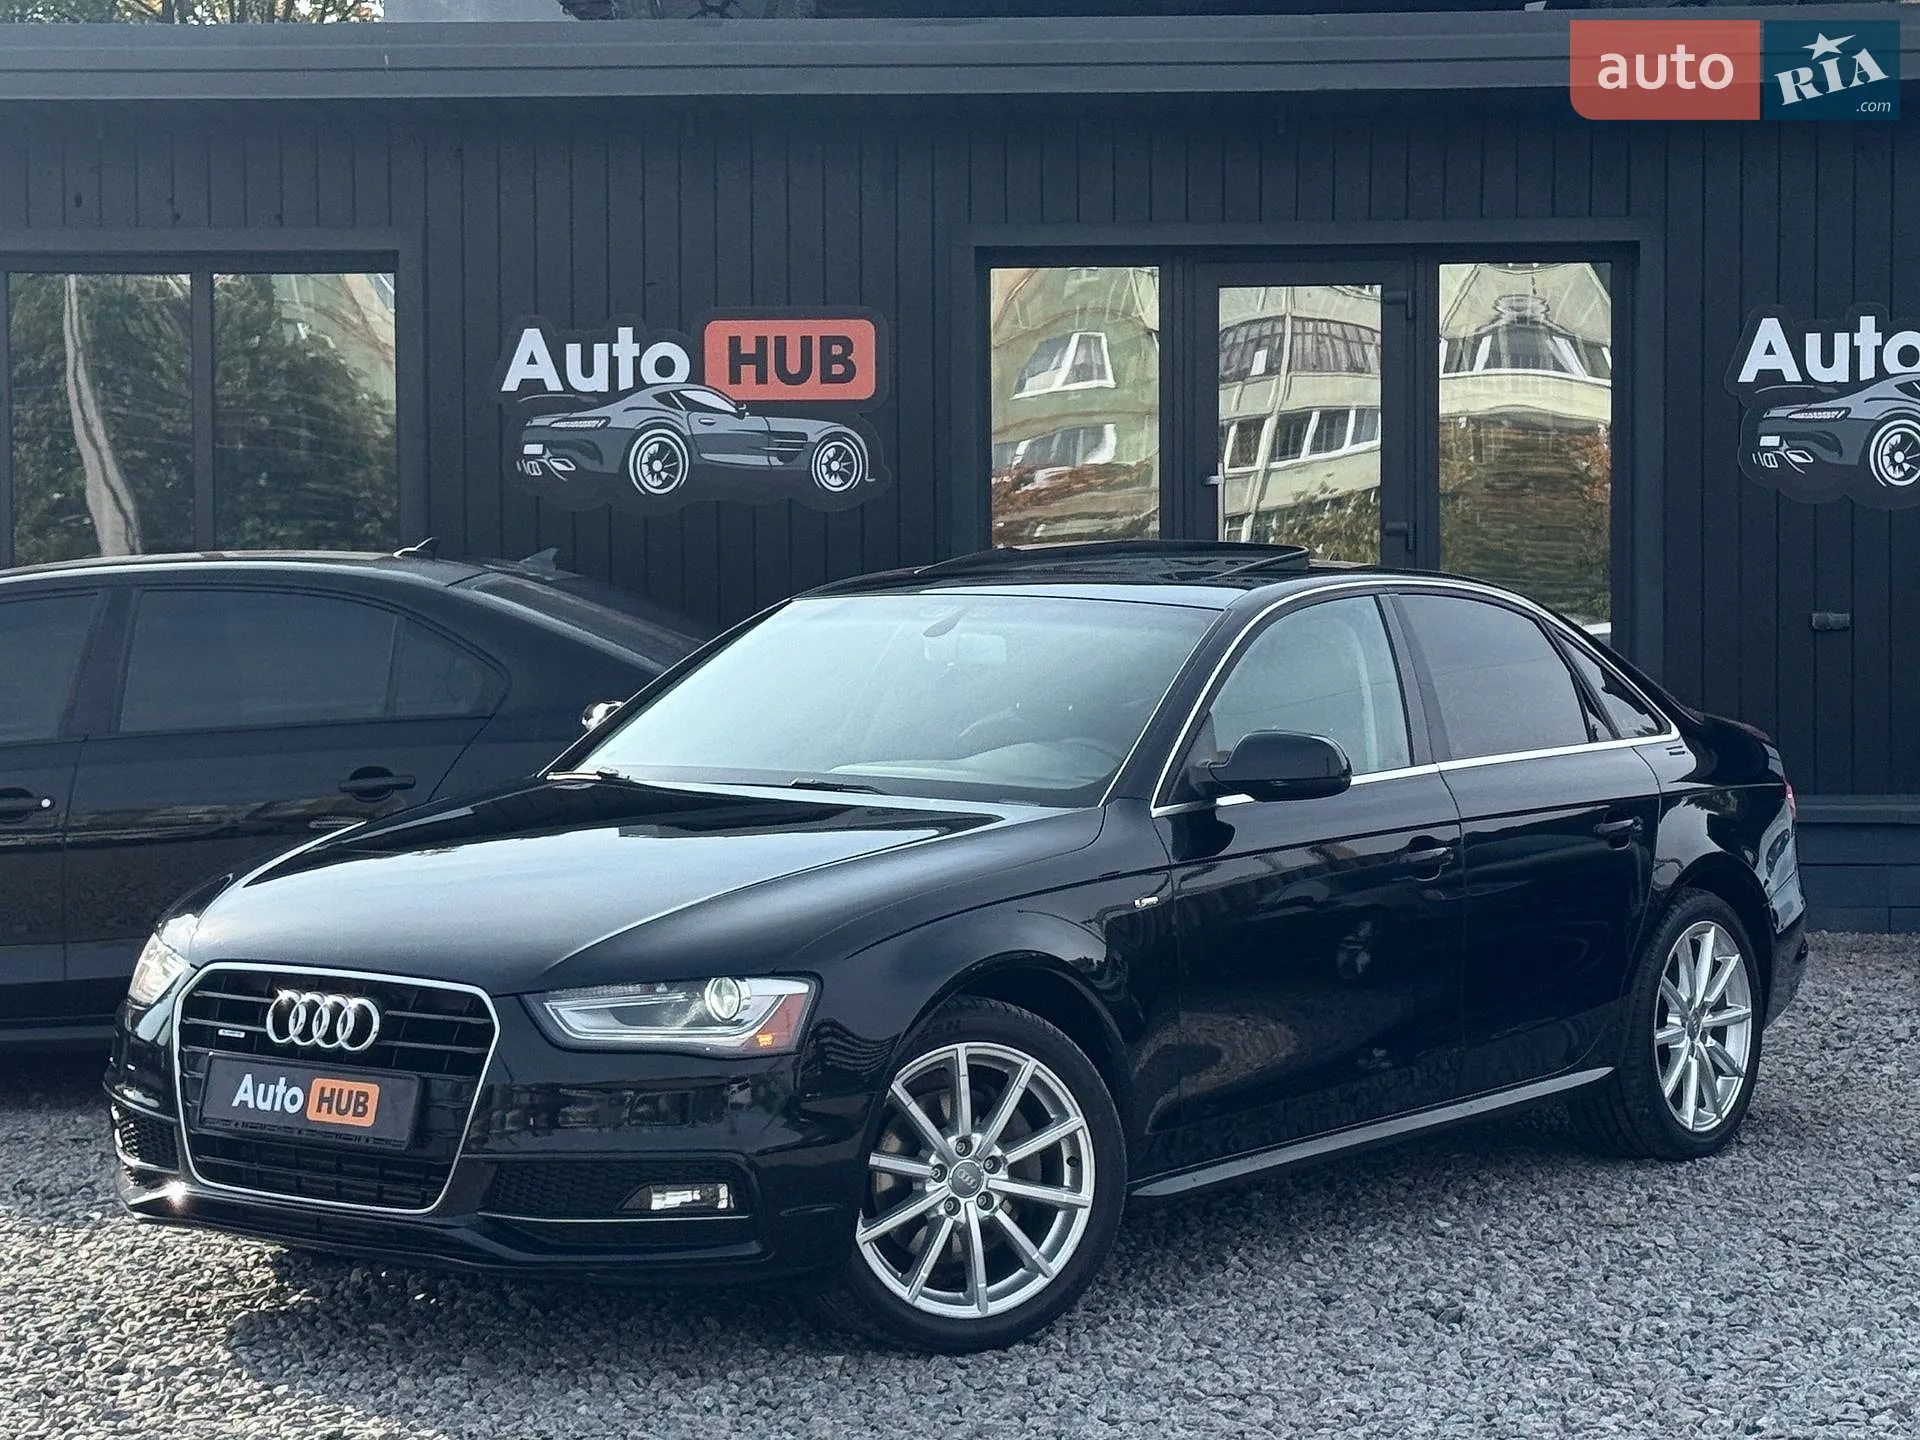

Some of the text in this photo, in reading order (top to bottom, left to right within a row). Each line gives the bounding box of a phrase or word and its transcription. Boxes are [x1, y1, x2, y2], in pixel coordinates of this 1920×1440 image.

[501, 326, 858, 392] Auto HUB
[1737, 315, 1920, 383] Auto
[232, 1073, 370, 1118] Auto HUB
